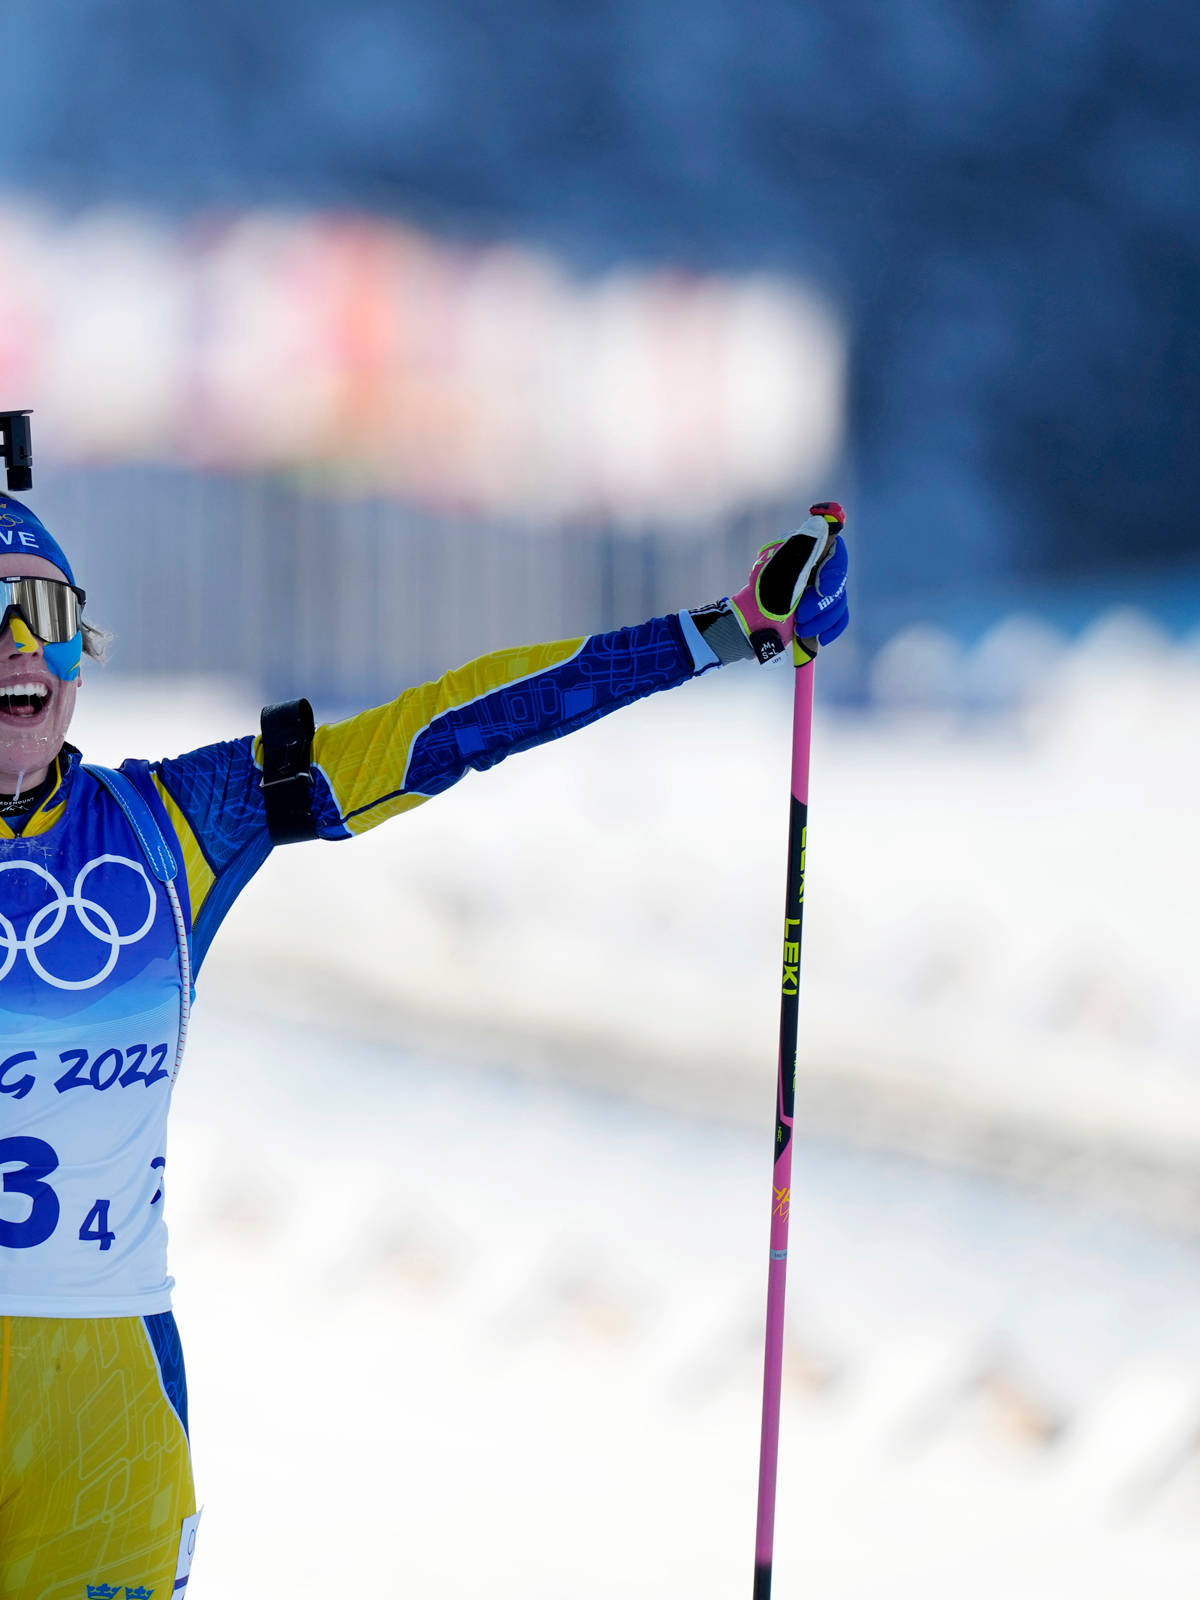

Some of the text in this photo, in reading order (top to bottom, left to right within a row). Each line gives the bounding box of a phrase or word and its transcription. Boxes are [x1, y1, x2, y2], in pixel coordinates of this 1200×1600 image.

[782, 918, 800, 996] LEKI
[53, 1043, 170, 1095] 2022
[78, 1199, 115, 1251] 4
